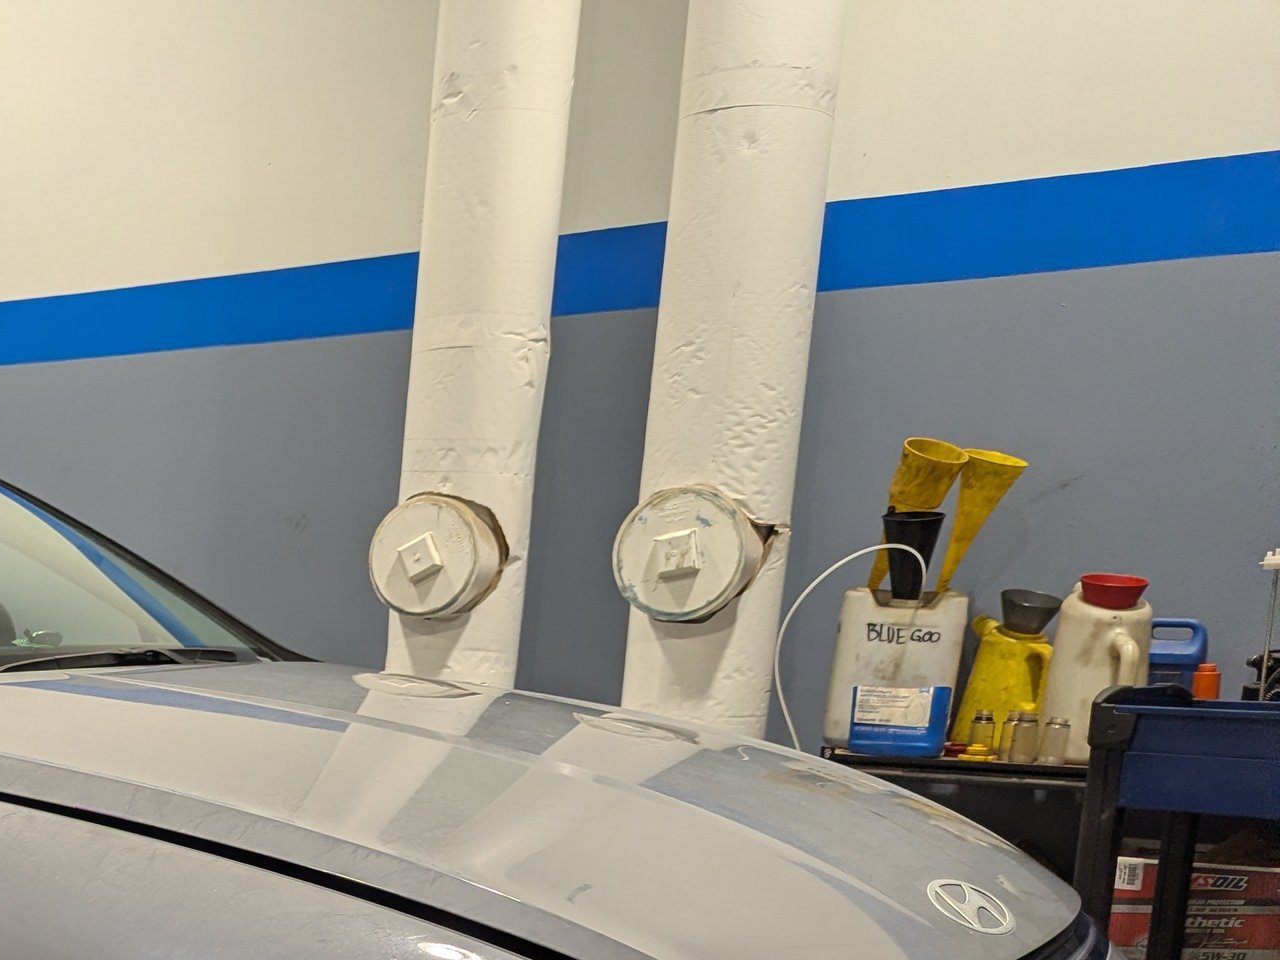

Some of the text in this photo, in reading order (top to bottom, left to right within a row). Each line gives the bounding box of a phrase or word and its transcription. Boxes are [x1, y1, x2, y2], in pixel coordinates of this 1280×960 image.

[867, 623, 941, 645] BLUE GOO
[1200, 951, 1247, 960] 5W-30
